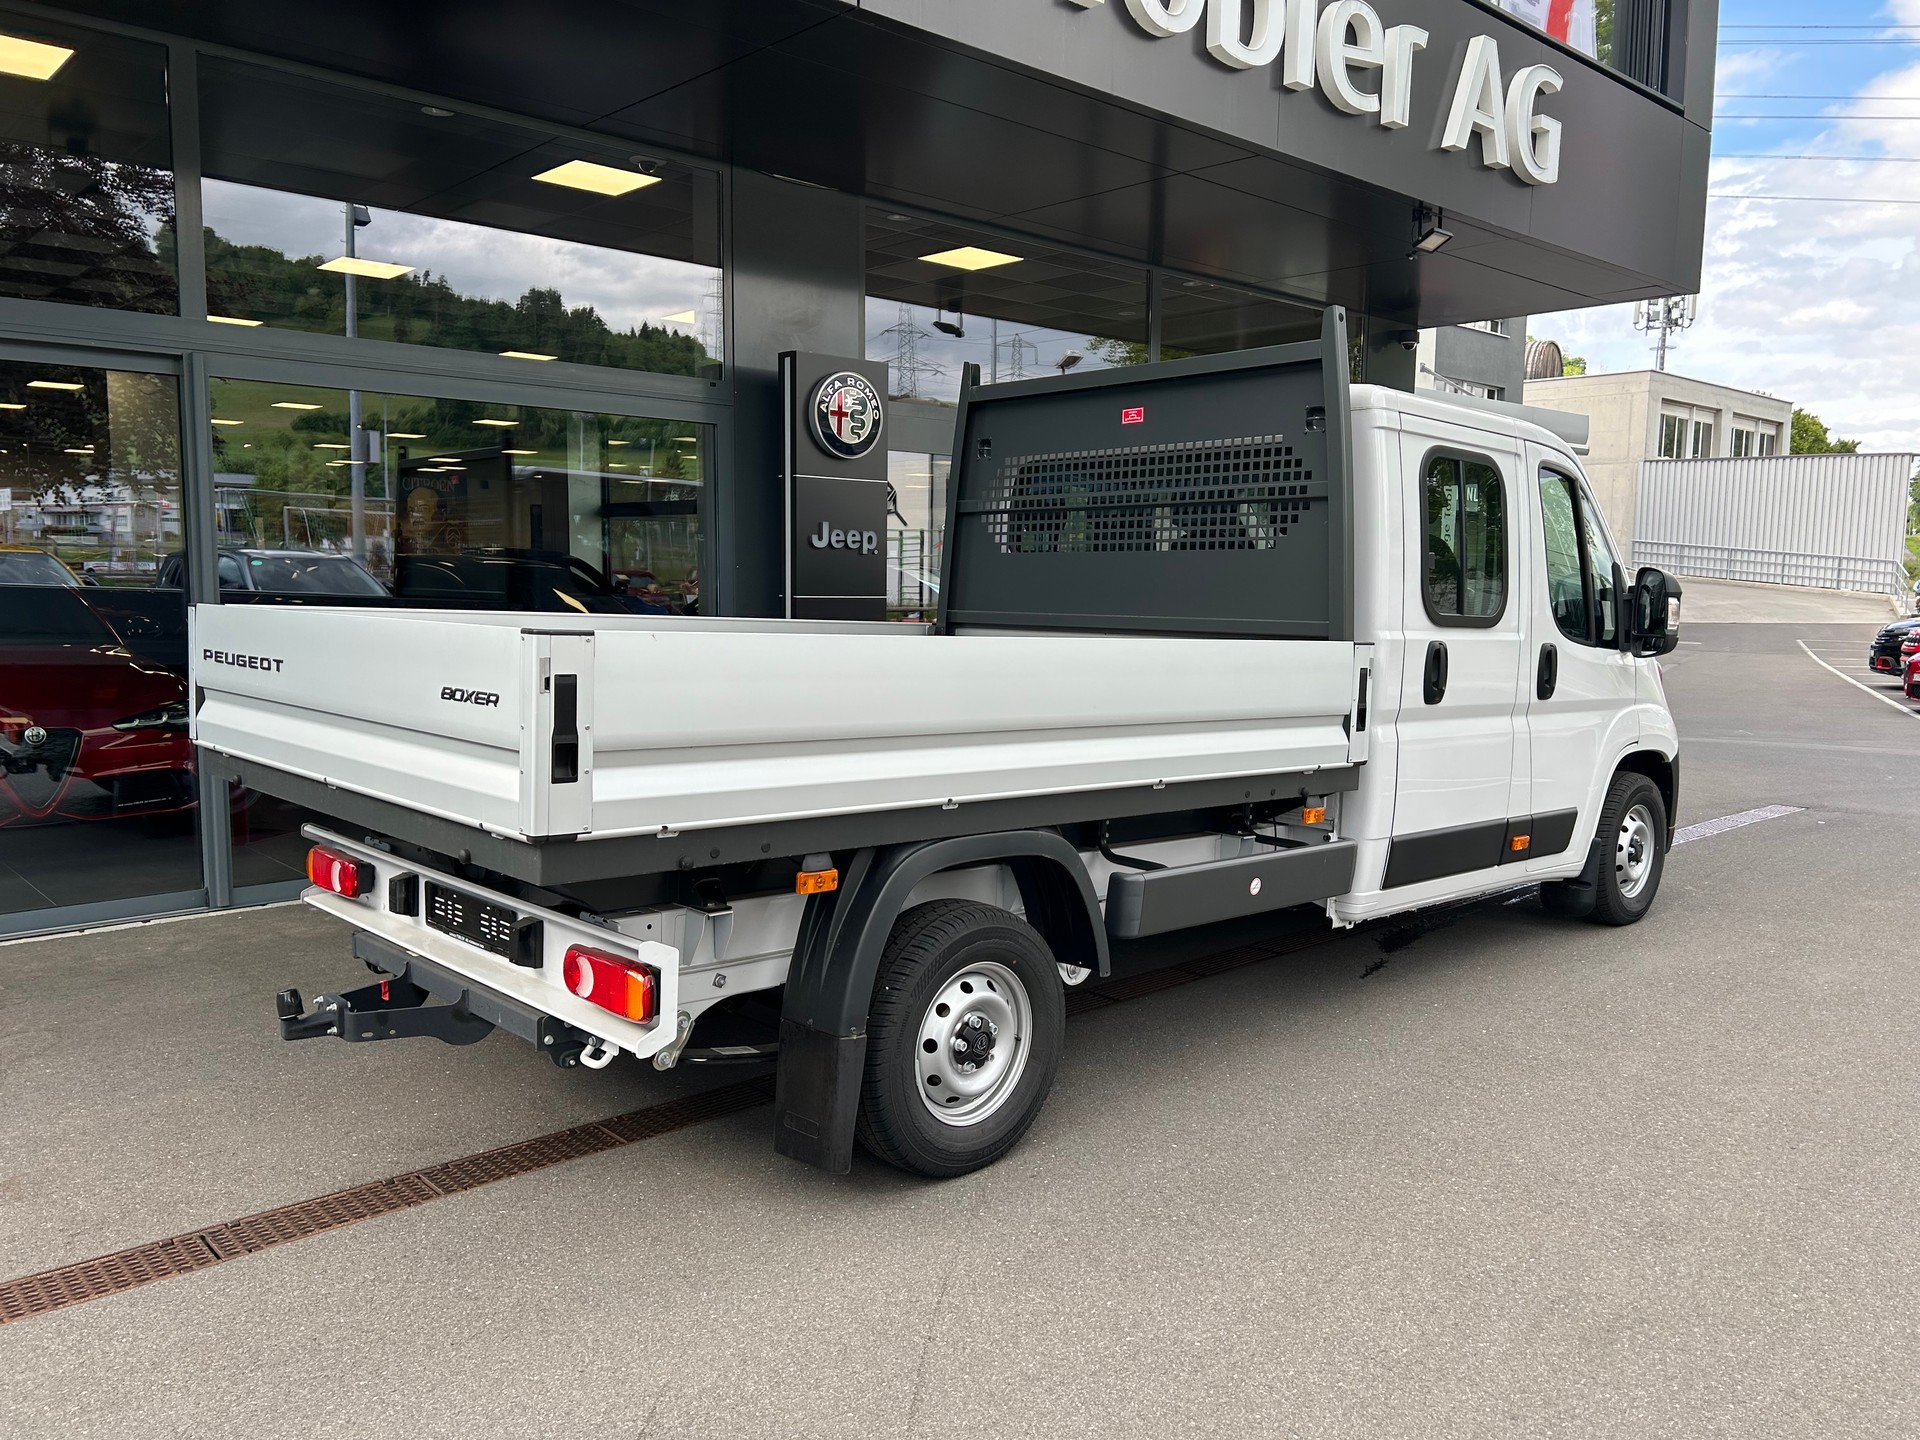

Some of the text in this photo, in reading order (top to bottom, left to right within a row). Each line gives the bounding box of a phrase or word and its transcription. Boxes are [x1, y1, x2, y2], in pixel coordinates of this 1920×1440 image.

[1440, 34, 1564, 186] AG
[819, 377, 880, 420] ALFA ROMEO
[203, 648, 284, 673] PEUGEOT
[440, 686, 500, 708] BOXER
